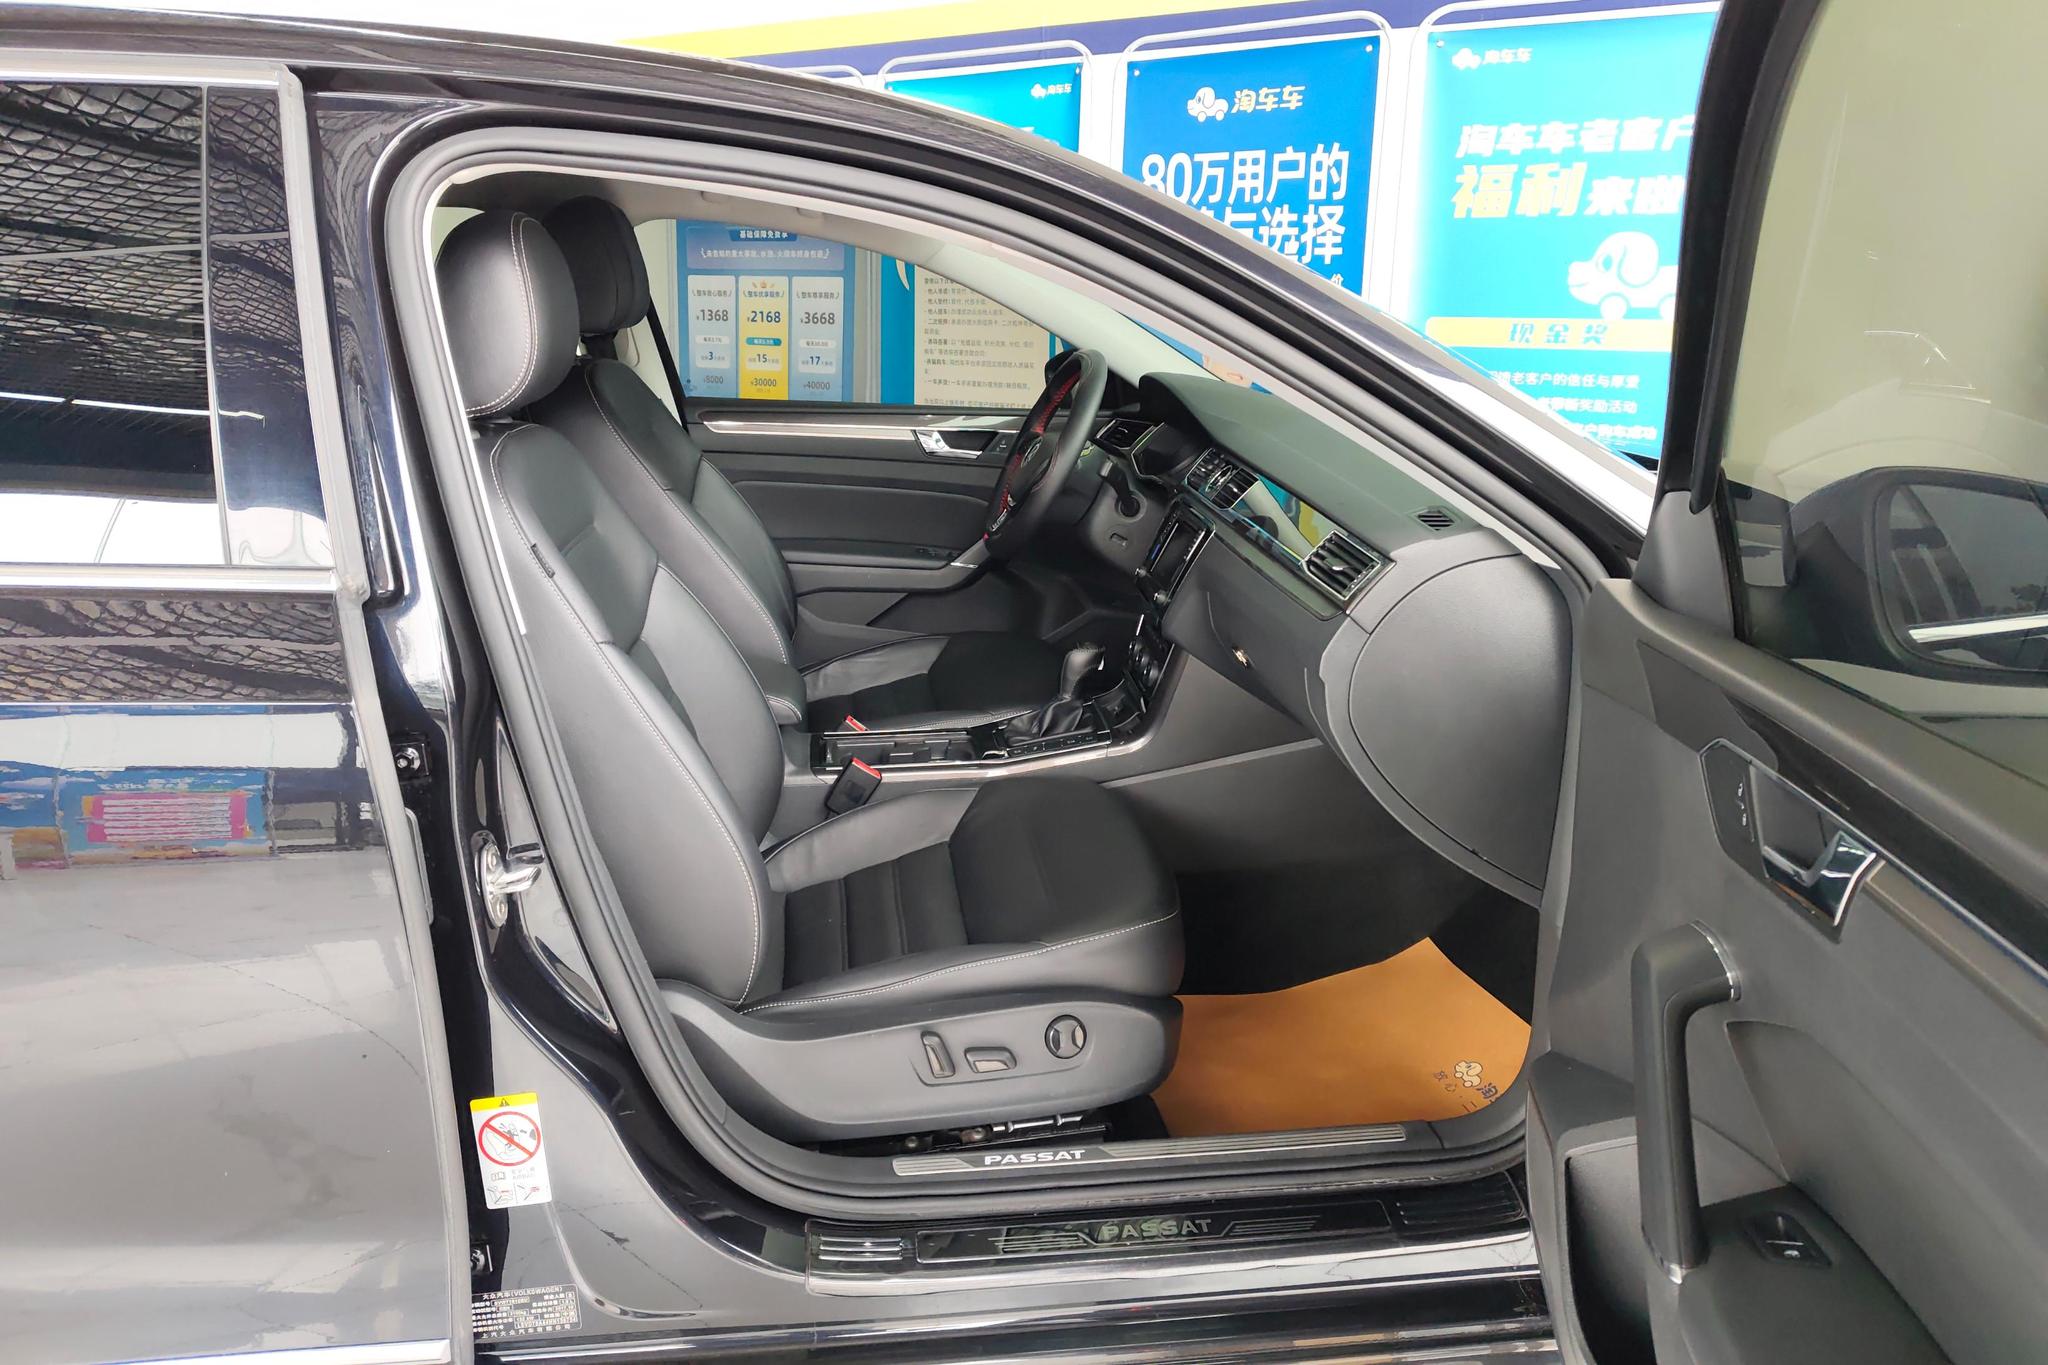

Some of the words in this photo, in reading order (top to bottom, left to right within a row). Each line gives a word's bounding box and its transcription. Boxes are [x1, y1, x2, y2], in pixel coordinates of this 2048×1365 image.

[1231, 85, 1306, 113] 淘车车
[1455, 114, 1696, 158] 淘车车老客户
[1141, 142, 1350, 206] 80万用户的
[1198, 204, 1346, 266] 与选择
[984, 1150, 1086, 1166] PASSAT
[1099, 1219, 1212, 1243] PASSAT
